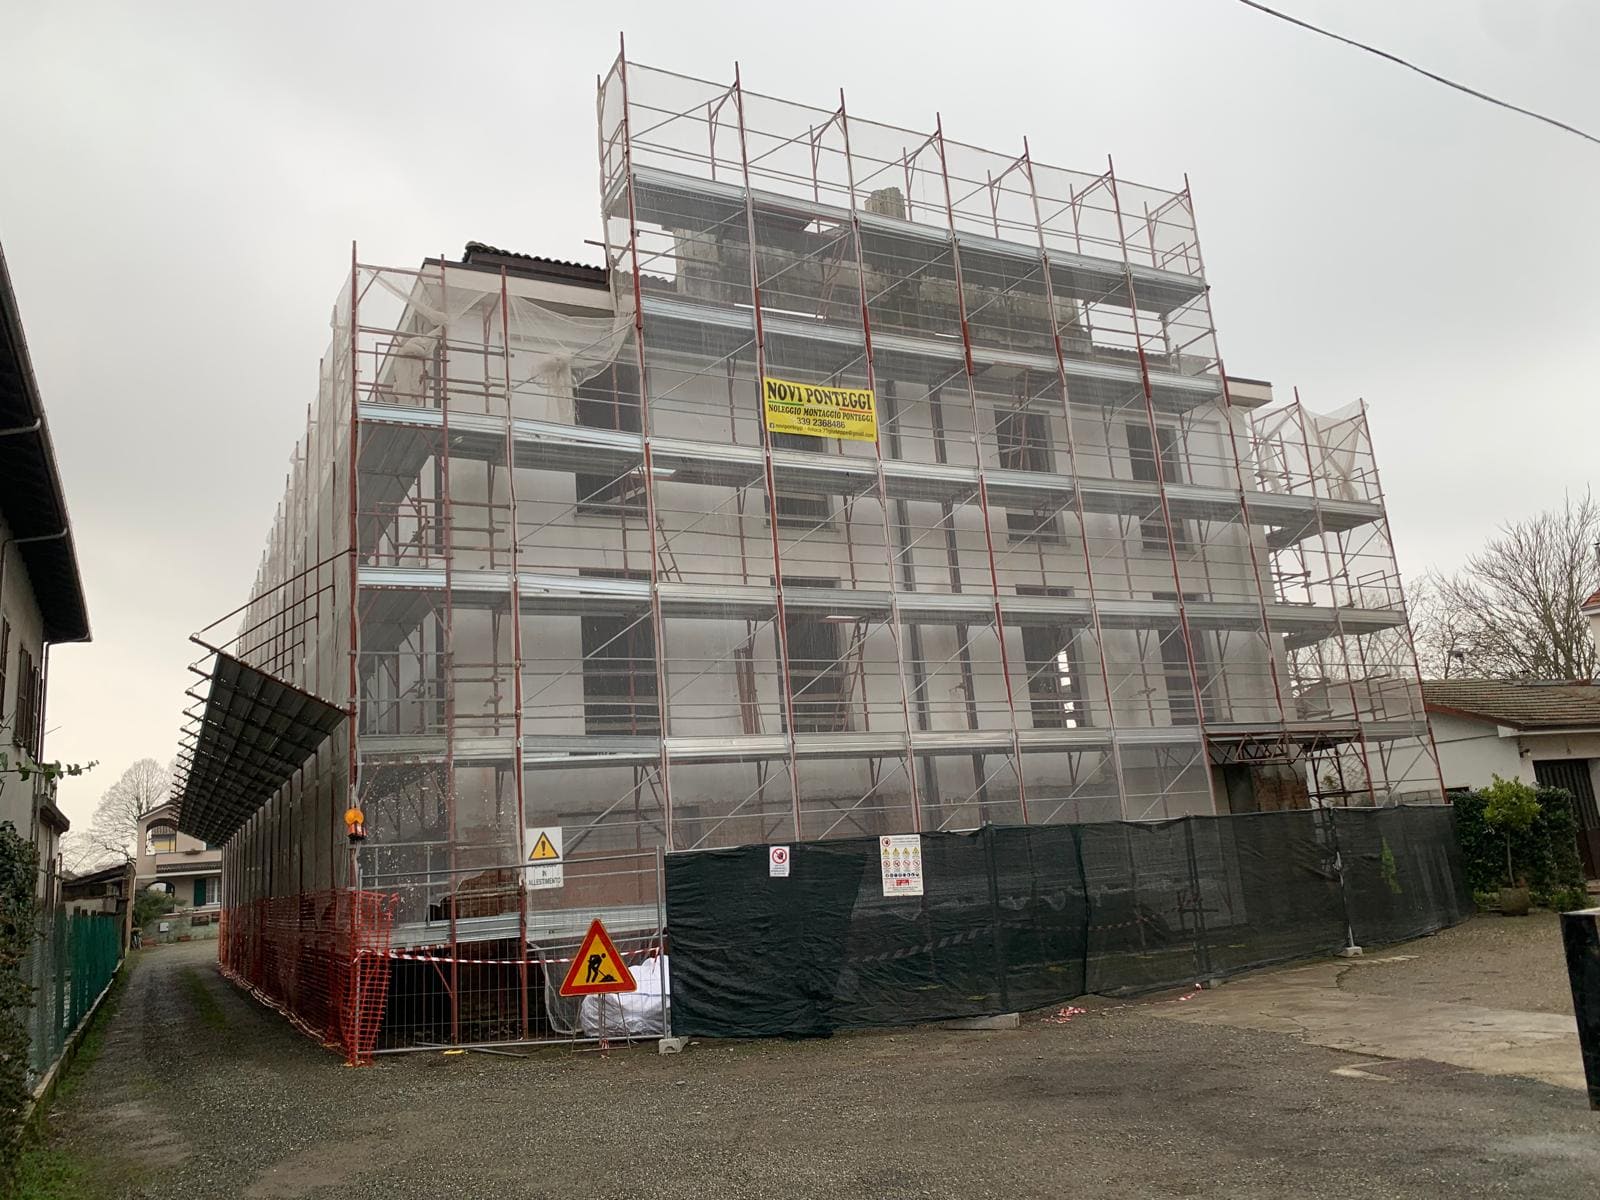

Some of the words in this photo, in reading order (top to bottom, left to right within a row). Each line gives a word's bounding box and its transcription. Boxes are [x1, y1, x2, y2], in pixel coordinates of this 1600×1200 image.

[766, 381, 803, 402] NOVI
[804, 388, 872, 410] PONTEGGI
[768, 404, 802, 416] NOLEGGIO
[803, 408, 842, 419] MONTAGGIO
[842, 412, 873, 423] PONTEGGI
[796, 417, 811, 426] 339
[812, 418, 846, 429] 2368486
